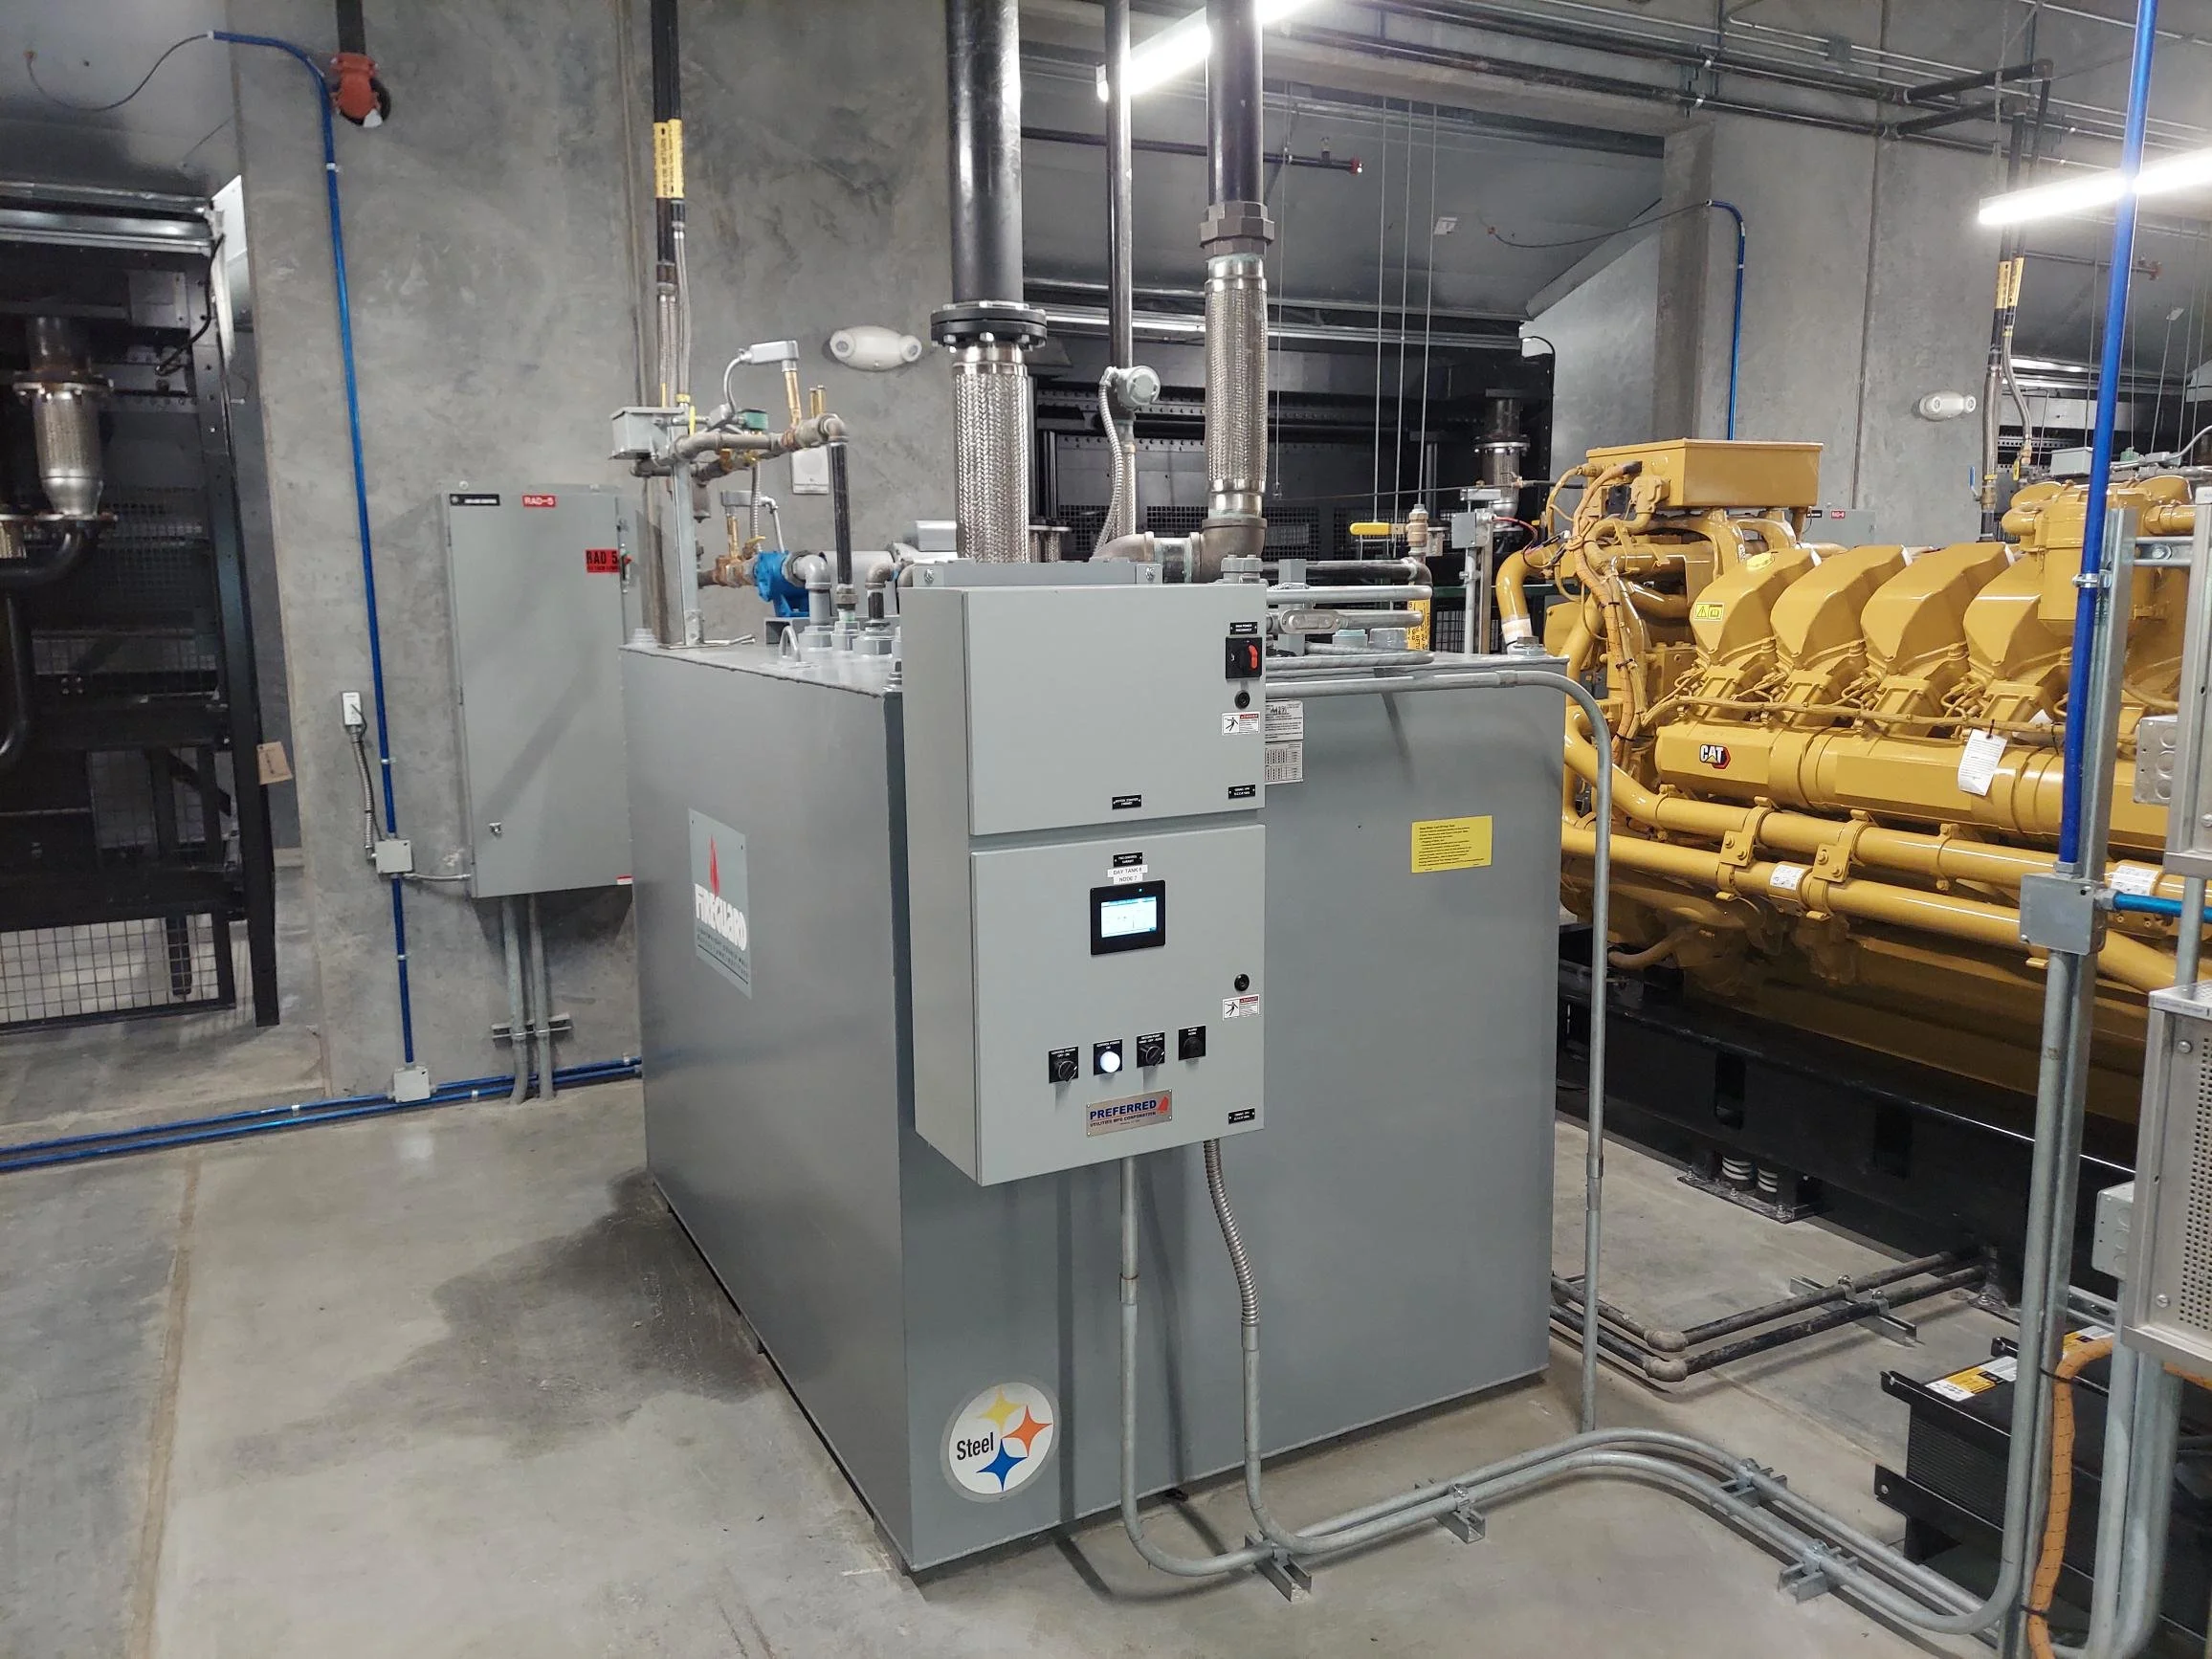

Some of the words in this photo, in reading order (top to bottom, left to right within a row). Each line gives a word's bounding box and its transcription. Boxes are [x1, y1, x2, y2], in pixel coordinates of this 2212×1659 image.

[523, 497, 555, 506] RAD-5
[586, 551, 607, 564] RAD
[612, 551, 618, 564] 5
[1700, 744, 1724, 763] CAT
[1090, 1100, 1157, 1119] PREFERRED
[957, 1432, 994, 1460] Steel
